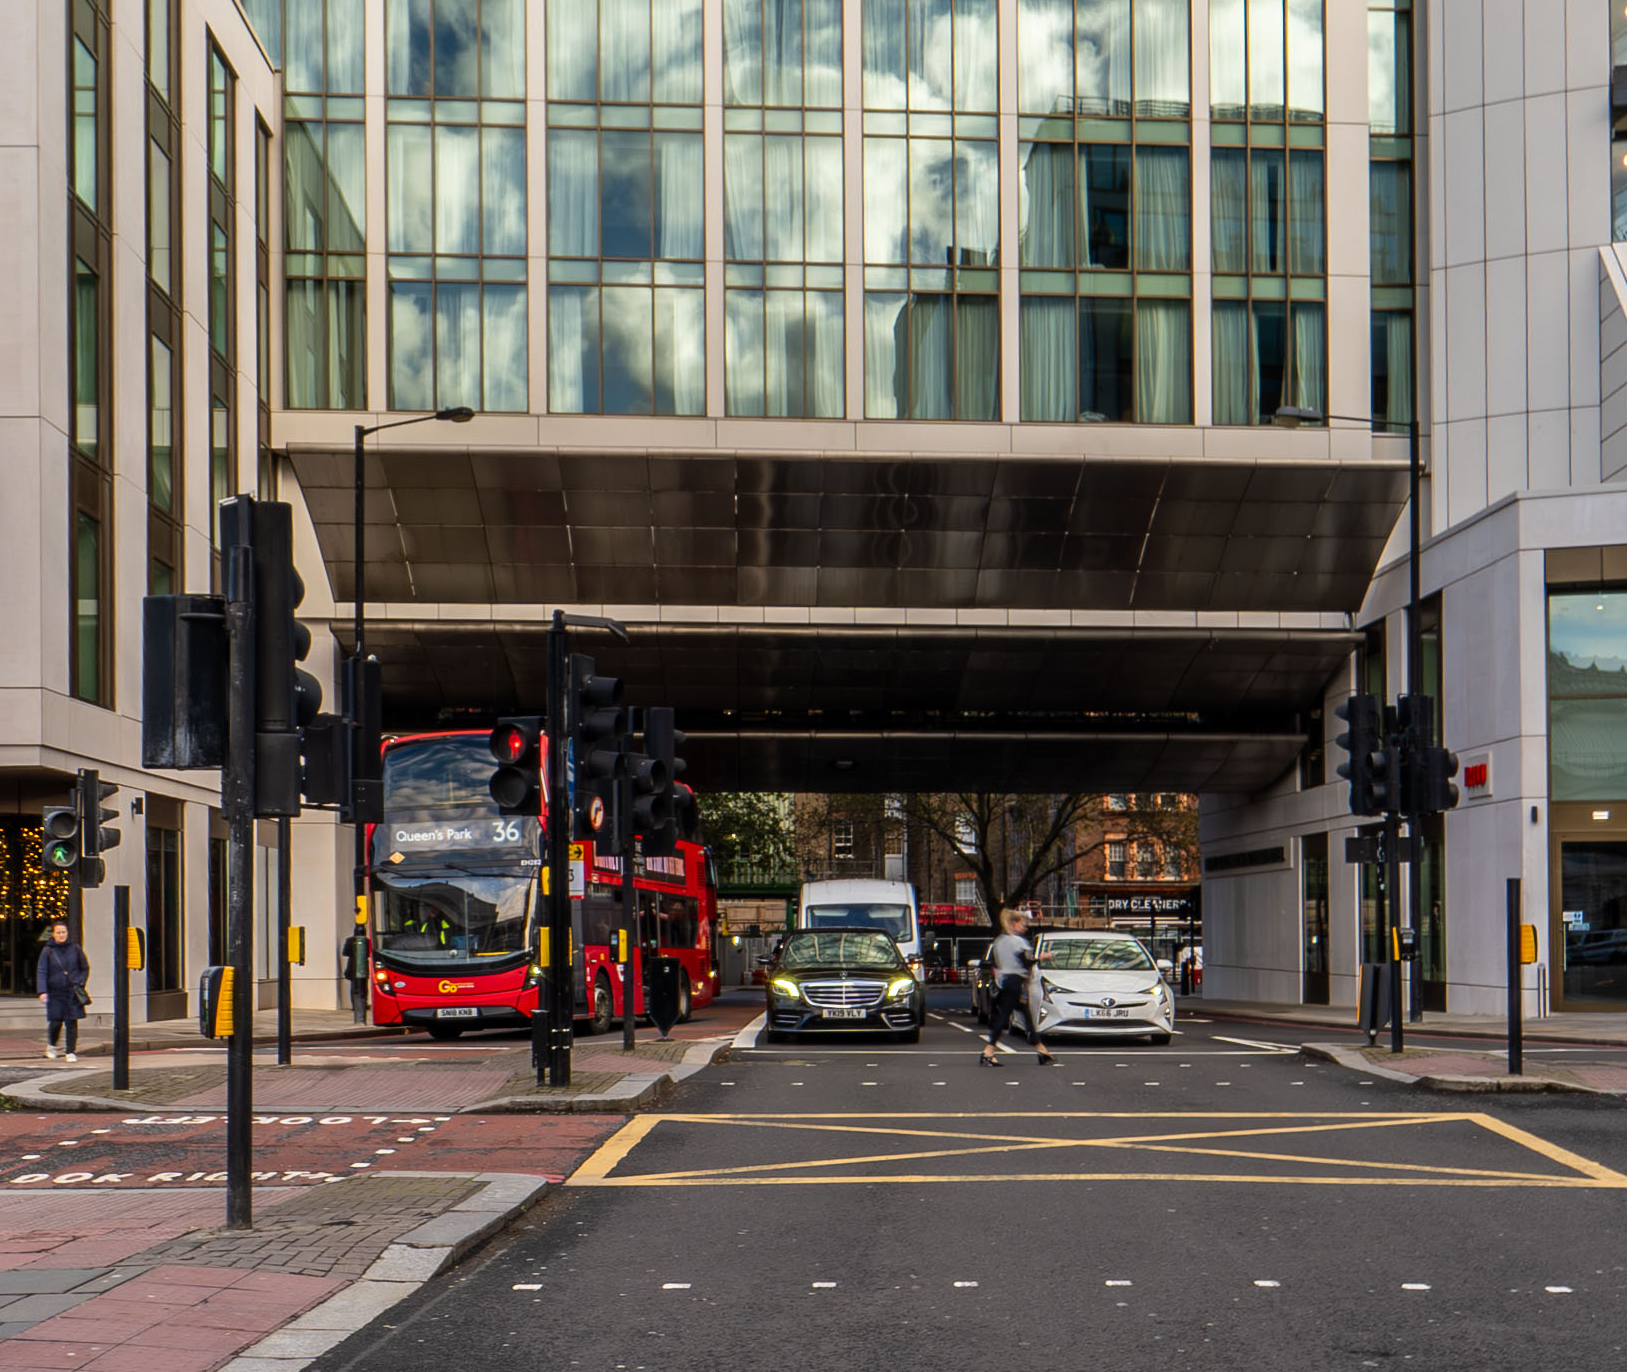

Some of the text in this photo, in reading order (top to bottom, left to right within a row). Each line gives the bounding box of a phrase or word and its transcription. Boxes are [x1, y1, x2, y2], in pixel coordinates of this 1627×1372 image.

[395, 820, 520, 842] Queen's Park 36
[1108, 899, 1129, 909] DRY
[438, 980, 457, 994] Go
[252, 1116, 389, 1125] LOOK
